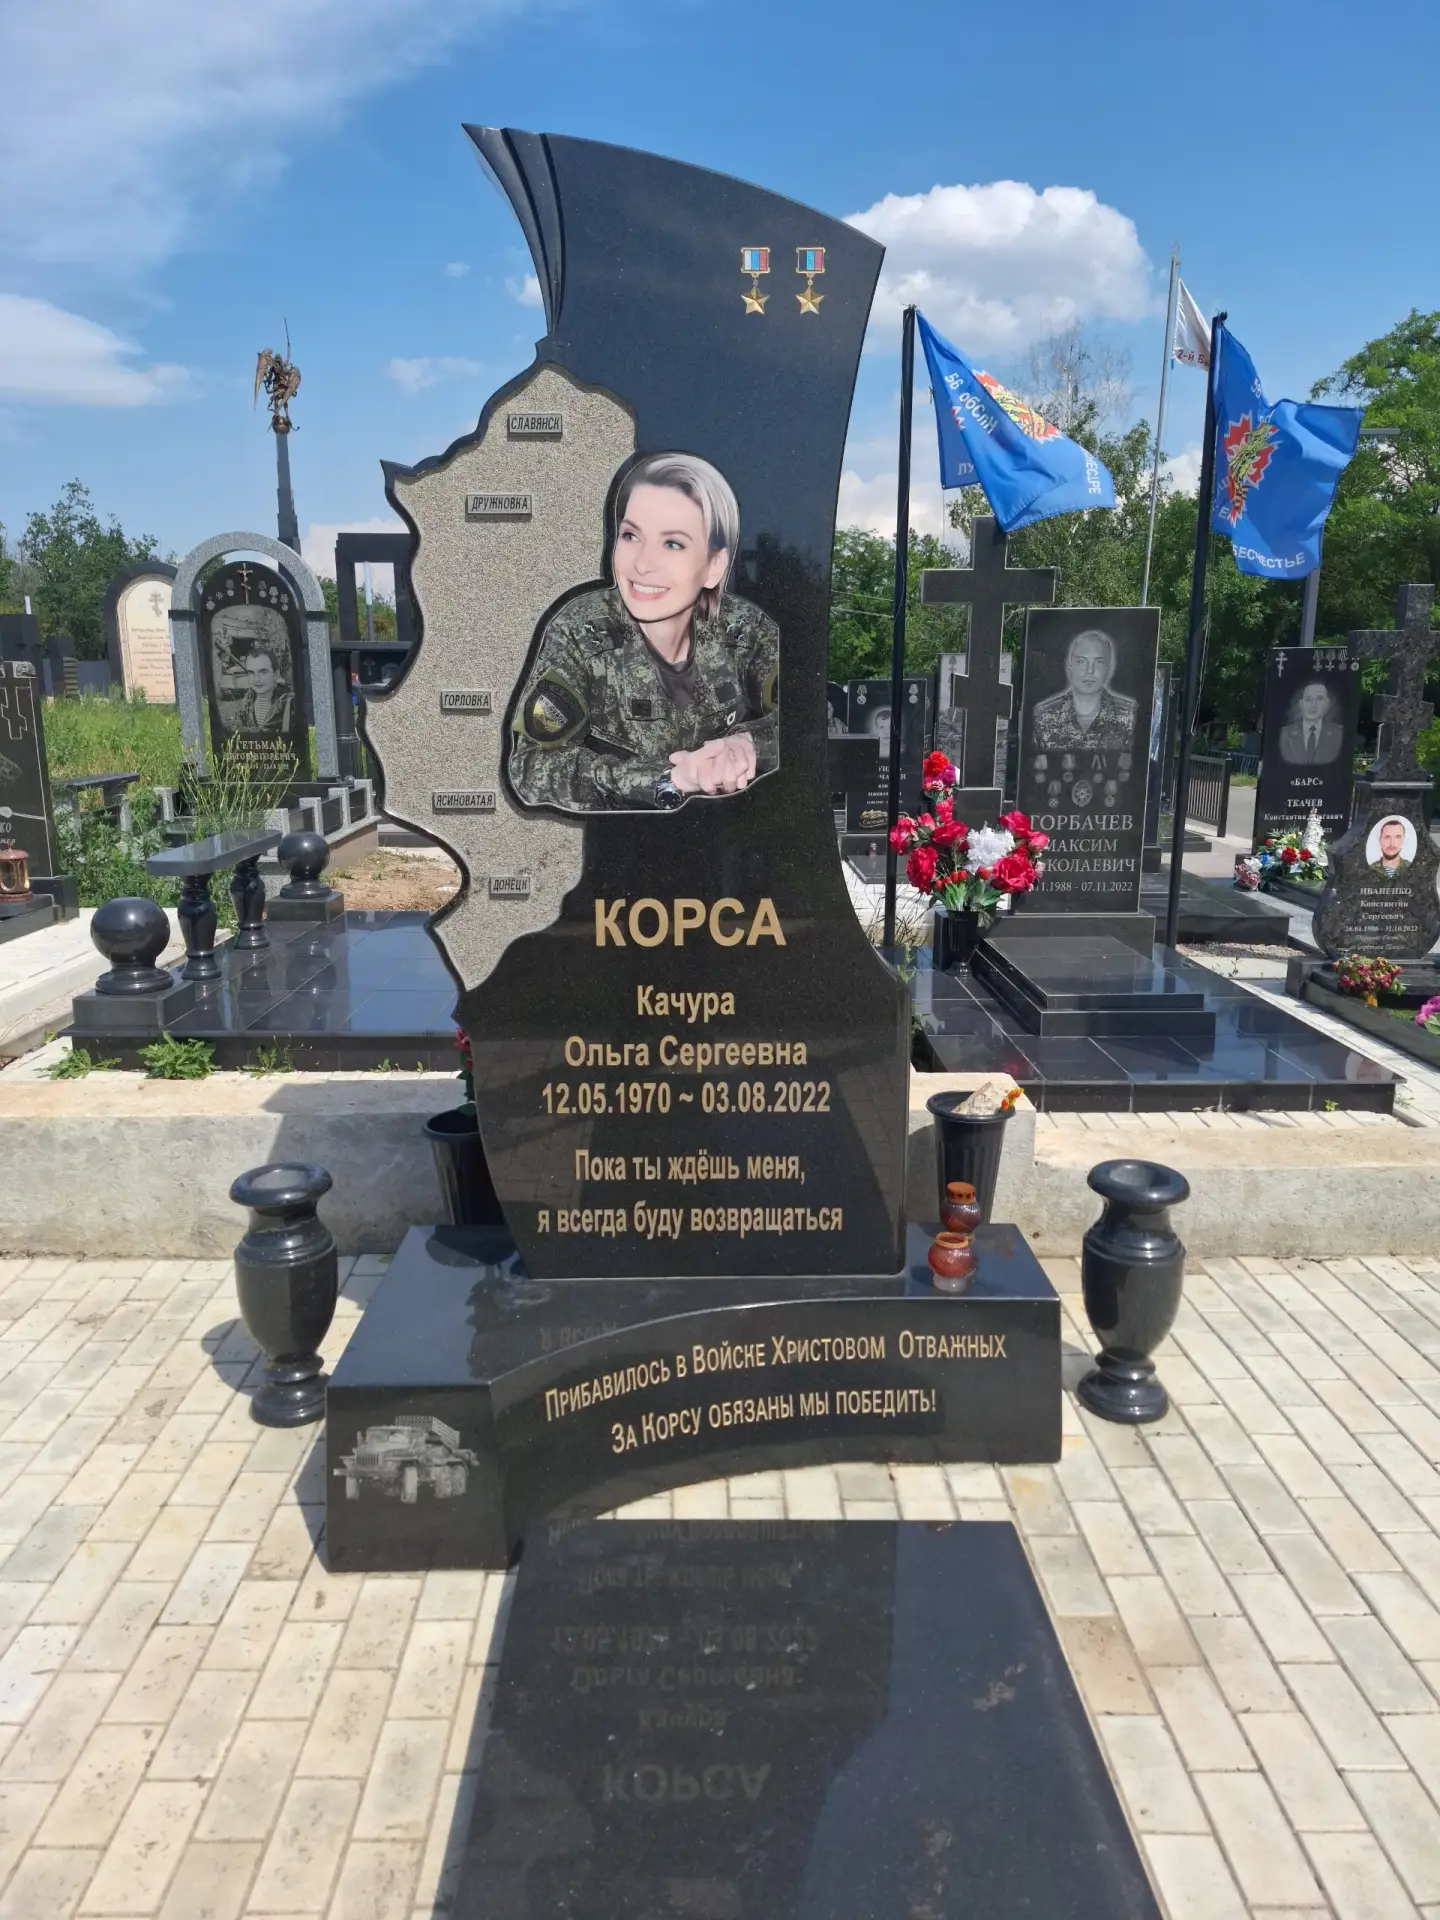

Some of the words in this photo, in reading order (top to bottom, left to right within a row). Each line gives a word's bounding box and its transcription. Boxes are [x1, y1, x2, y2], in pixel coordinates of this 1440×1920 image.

[944, 372, 964, 391] 56
[511, 417, 559, 430] СЛАВЯНСК
[471, 496, 528, 511] ДРУЖКОВКА
[444, 694, 489, 706] ГОРЛОВКА
[436, 795, 493, 806] ЯСИНОВАТАЯ
[1287, 798, 1323, 807] ТКАЧЕВ
[1030, 814, 1133, 831] ГОРБАЧЕВ
[1047, 839, 1118, 852] МАКСИМ
[1043, 859, 1136, 872] КОЛАЕВИЧ
[493, 879, 527, 892] ДОНЕЦК
[1081, 881, 1133, 892] 07.11.2022
[1360, 887, 1412, 896] ИВАНЕНКО
[594, 897, 787, 947] КОРСА
[637, 985, 735, 1023] Качура
[564, 1036, 650, 1067] Ольга
[659, 1035, 807, 1073] Сергеевна
[542, 1083, 671, 1114] 12.05.1970
[701, 1081, 831, 1113] 03.08.2022
[575, 1149, 626, 1181] Пока
[633, 1158, 661, 1180] ты
[667, 1150, 740, 1186] ждёшь
[747, 1156, 806, 1185] меня,
[537, 1209, 550, 1232] я
[557, 1208, 627, 1237] всегда
[633, 1200, 684, 1239] буду
[690, 1206, 843, 1238] возвращаться
